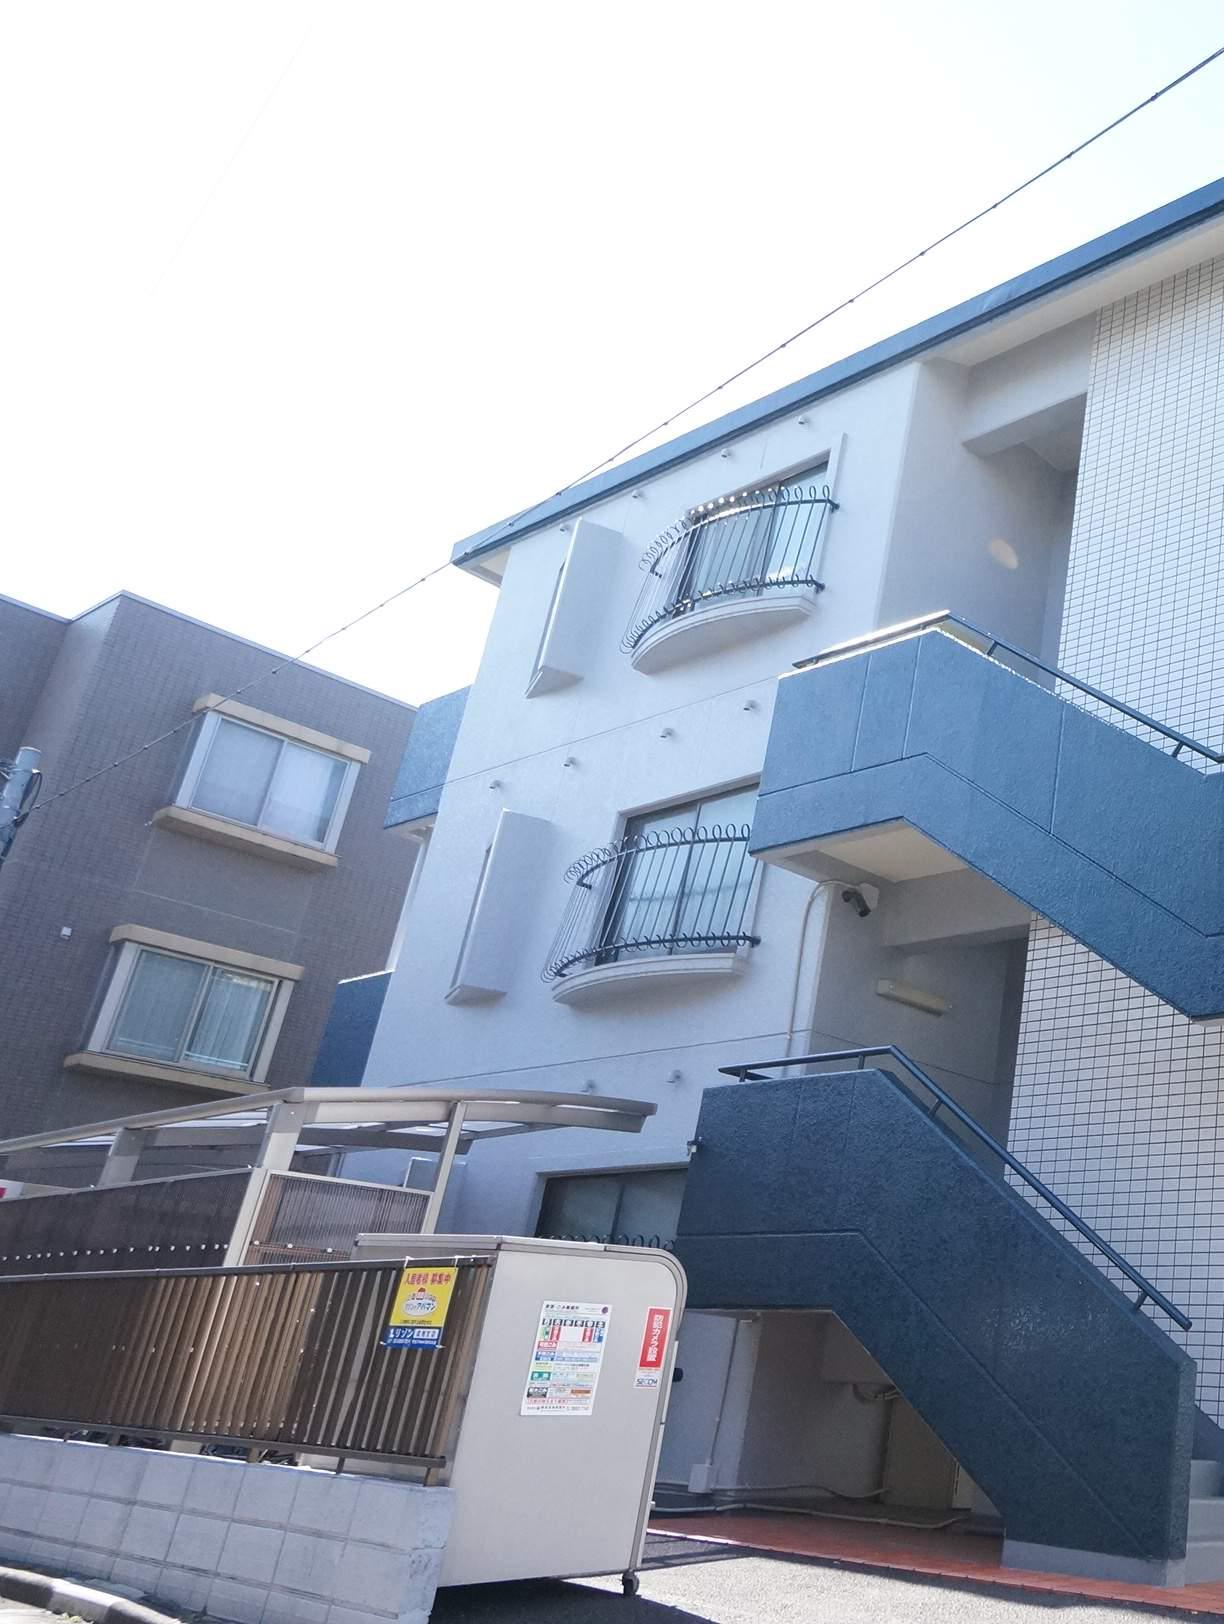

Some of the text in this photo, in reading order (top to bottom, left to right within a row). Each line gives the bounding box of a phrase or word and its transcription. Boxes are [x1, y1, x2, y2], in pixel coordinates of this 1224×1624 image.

[431, 1273, 451, 1285] 募集中
[395, 1328, 414, 1338] リゾン
[646, 1314, 664, 1362] 防犯カメラ設置
